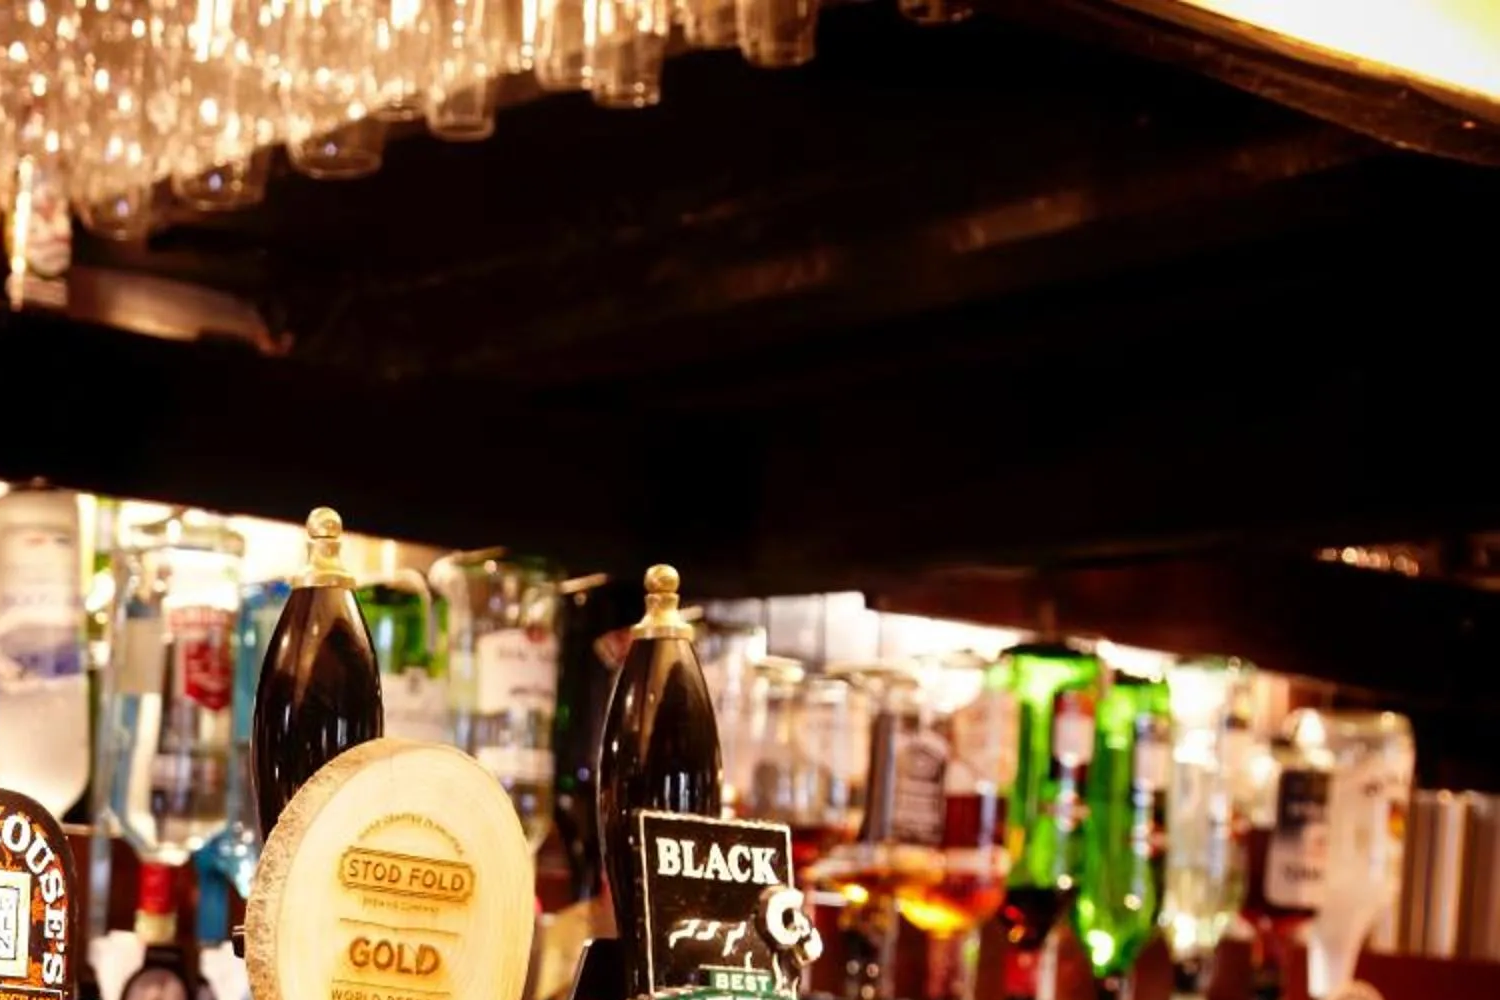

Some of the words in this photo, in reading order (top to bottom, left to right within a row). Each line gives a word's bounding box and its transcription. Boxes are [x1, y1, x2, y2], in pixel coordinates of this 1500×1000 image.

[349, 858, 401, 883] STOD
[409, 868, 465, 892] FOLD
[656, 837, 779, 884] BLACK
[350, 936, 440, 976] GOLD
[714, 972, 770, 992] BEST
